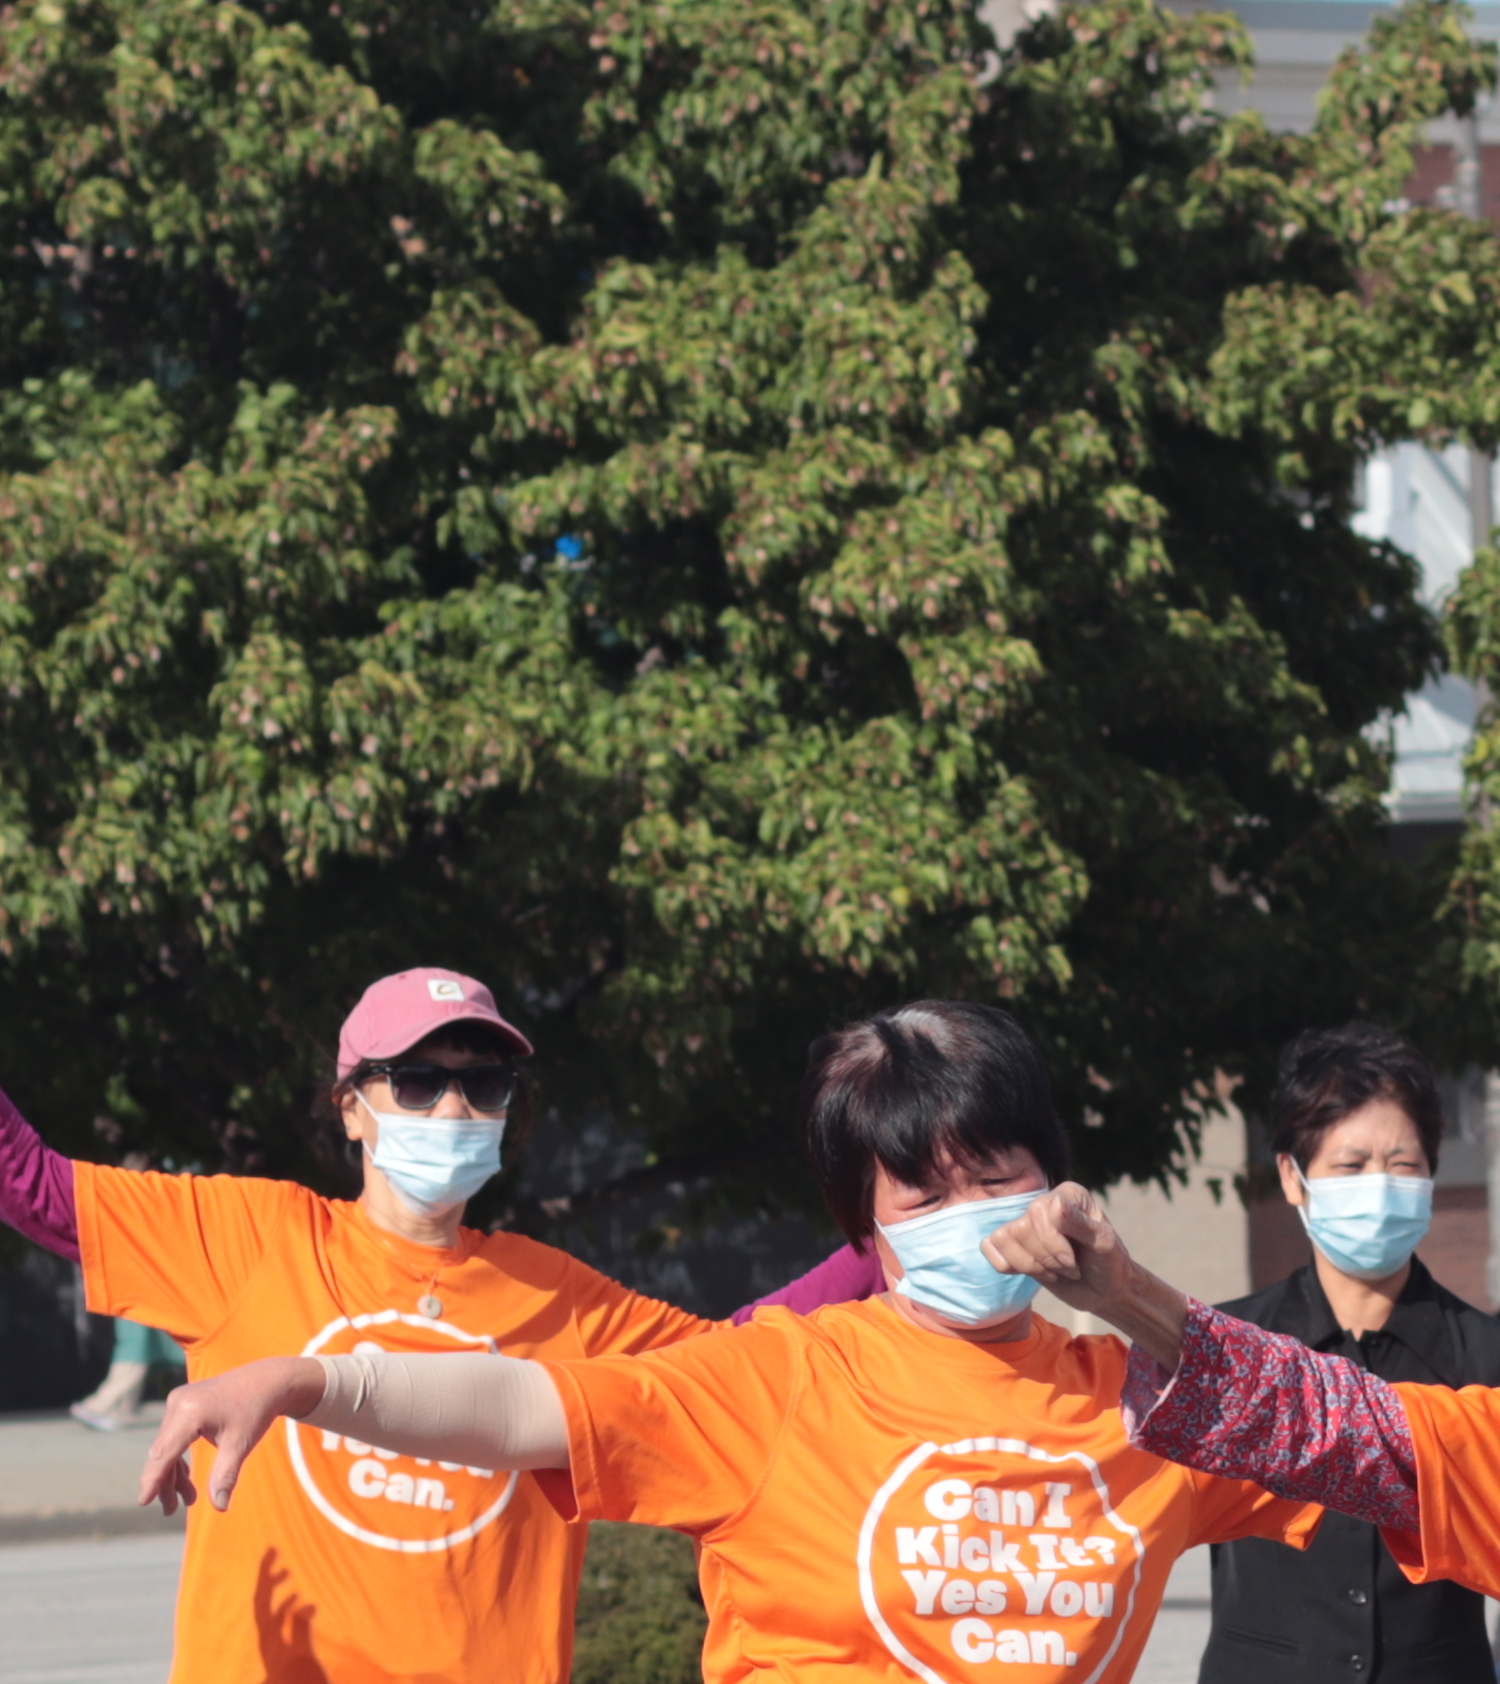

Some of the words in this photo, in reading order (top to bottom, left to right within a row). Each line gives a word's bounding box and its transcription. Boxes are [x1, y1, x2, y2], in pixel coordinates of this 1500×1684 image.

[348, 1459, 455, 1512] Can.
[924, 1478, 1036, 1527] Can
[1042, 1481, 1072, 1528] I
[895, 1524, 1028, 1573] Kick
[1029, 1533, 1116, 1570] It?
[900, 1569, 1008, 1615] Yes
[1012, 1571, 1114, 1618] You
[951, 1617, 1078, 1666] Can.
